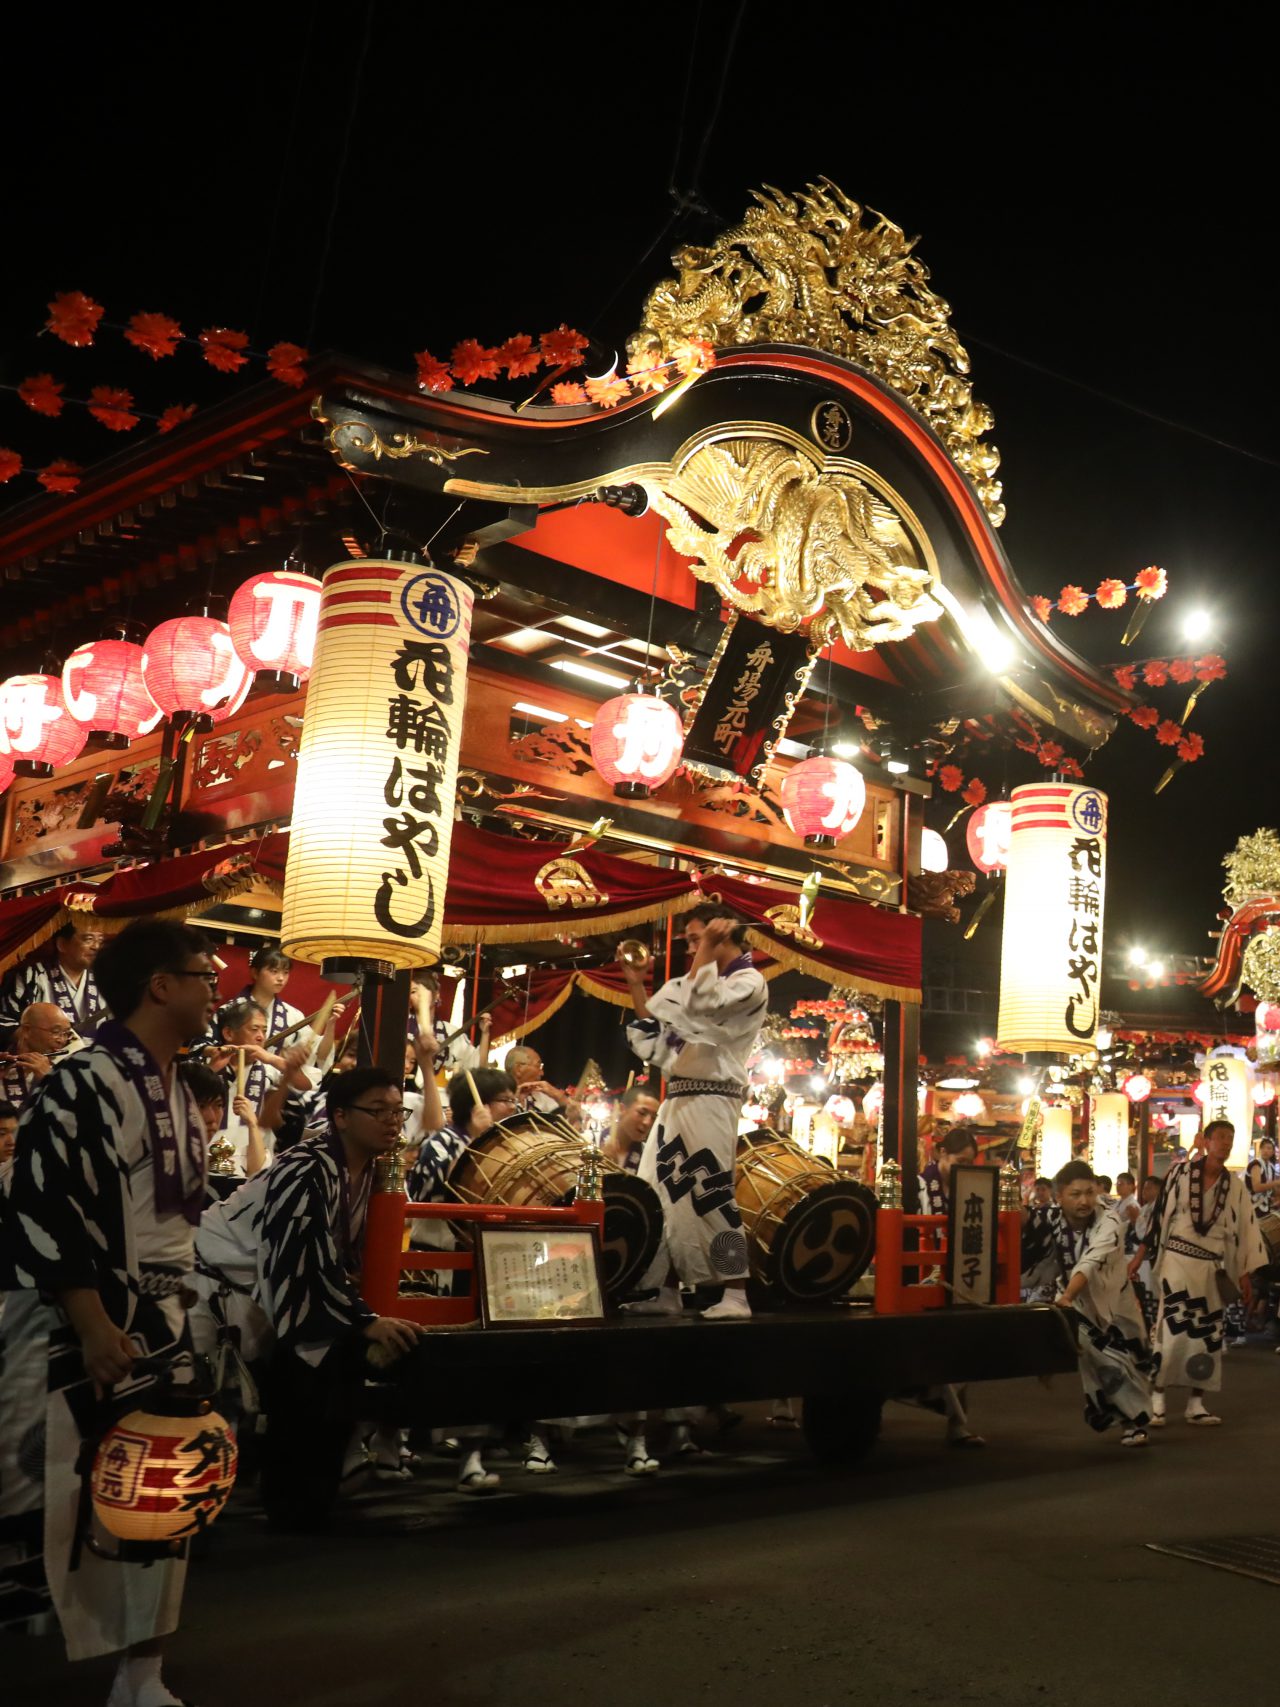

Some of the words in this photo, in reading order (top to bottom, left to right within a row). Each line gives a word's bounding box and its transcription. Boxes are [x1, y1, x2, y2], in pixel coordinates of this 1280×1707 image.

[374, 640, 455, 939] 花輪ばやし
[714, 640, 775, 756] 舟場元町
